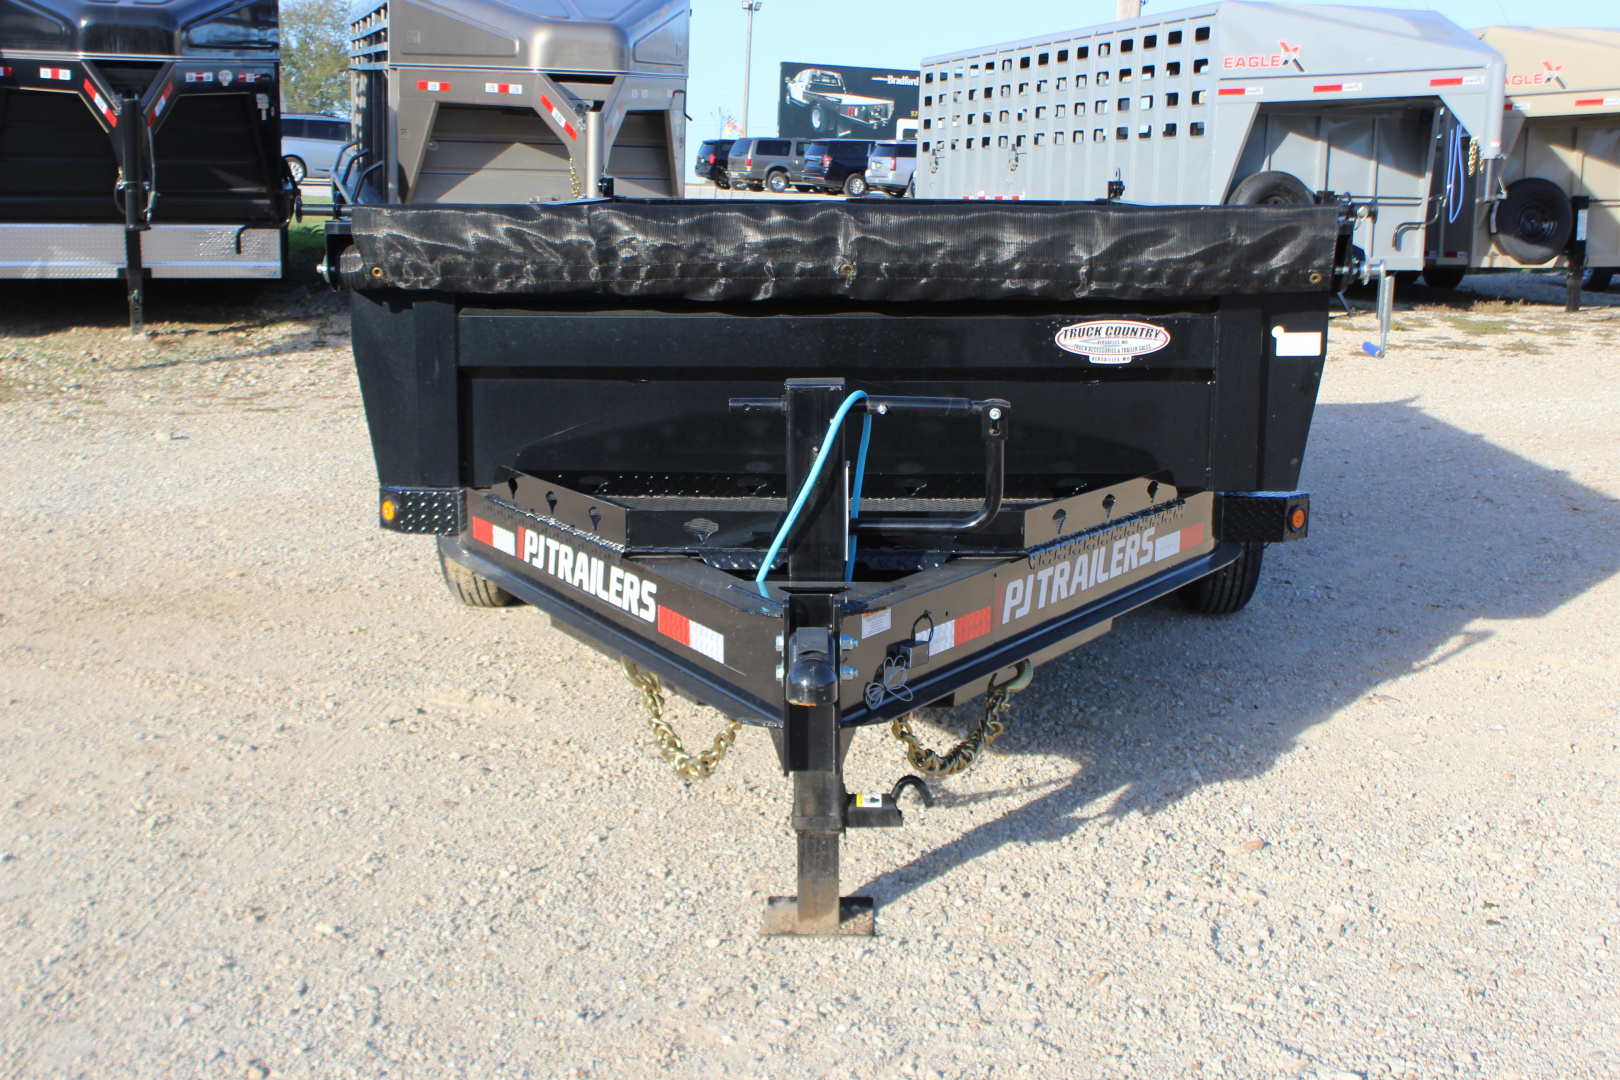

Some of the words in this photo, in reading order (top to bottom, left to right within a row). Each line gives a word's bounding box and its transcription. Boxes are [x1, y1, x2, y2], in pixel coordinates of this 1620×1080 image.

[887, 74, 919, 86] Bradford
[1063, 326, 1103, 339] TRUCK
[1105, 326, 1162, 339] COUNTRY
[1073, 343, 1088, 352] TRUCK
[1088, 346, 1117, 354] ACCESSORIES
[1121, 346, 1138, 354] TRAILER
[1138, 344, 1152, 352] SALES
[524, 528, 546, 570] PJ
[546, 537, 658, 623] TRAILERS
[1002, 574, 1034, 625] PJ
[1037, 526, 1156, 610] TRAILERS
